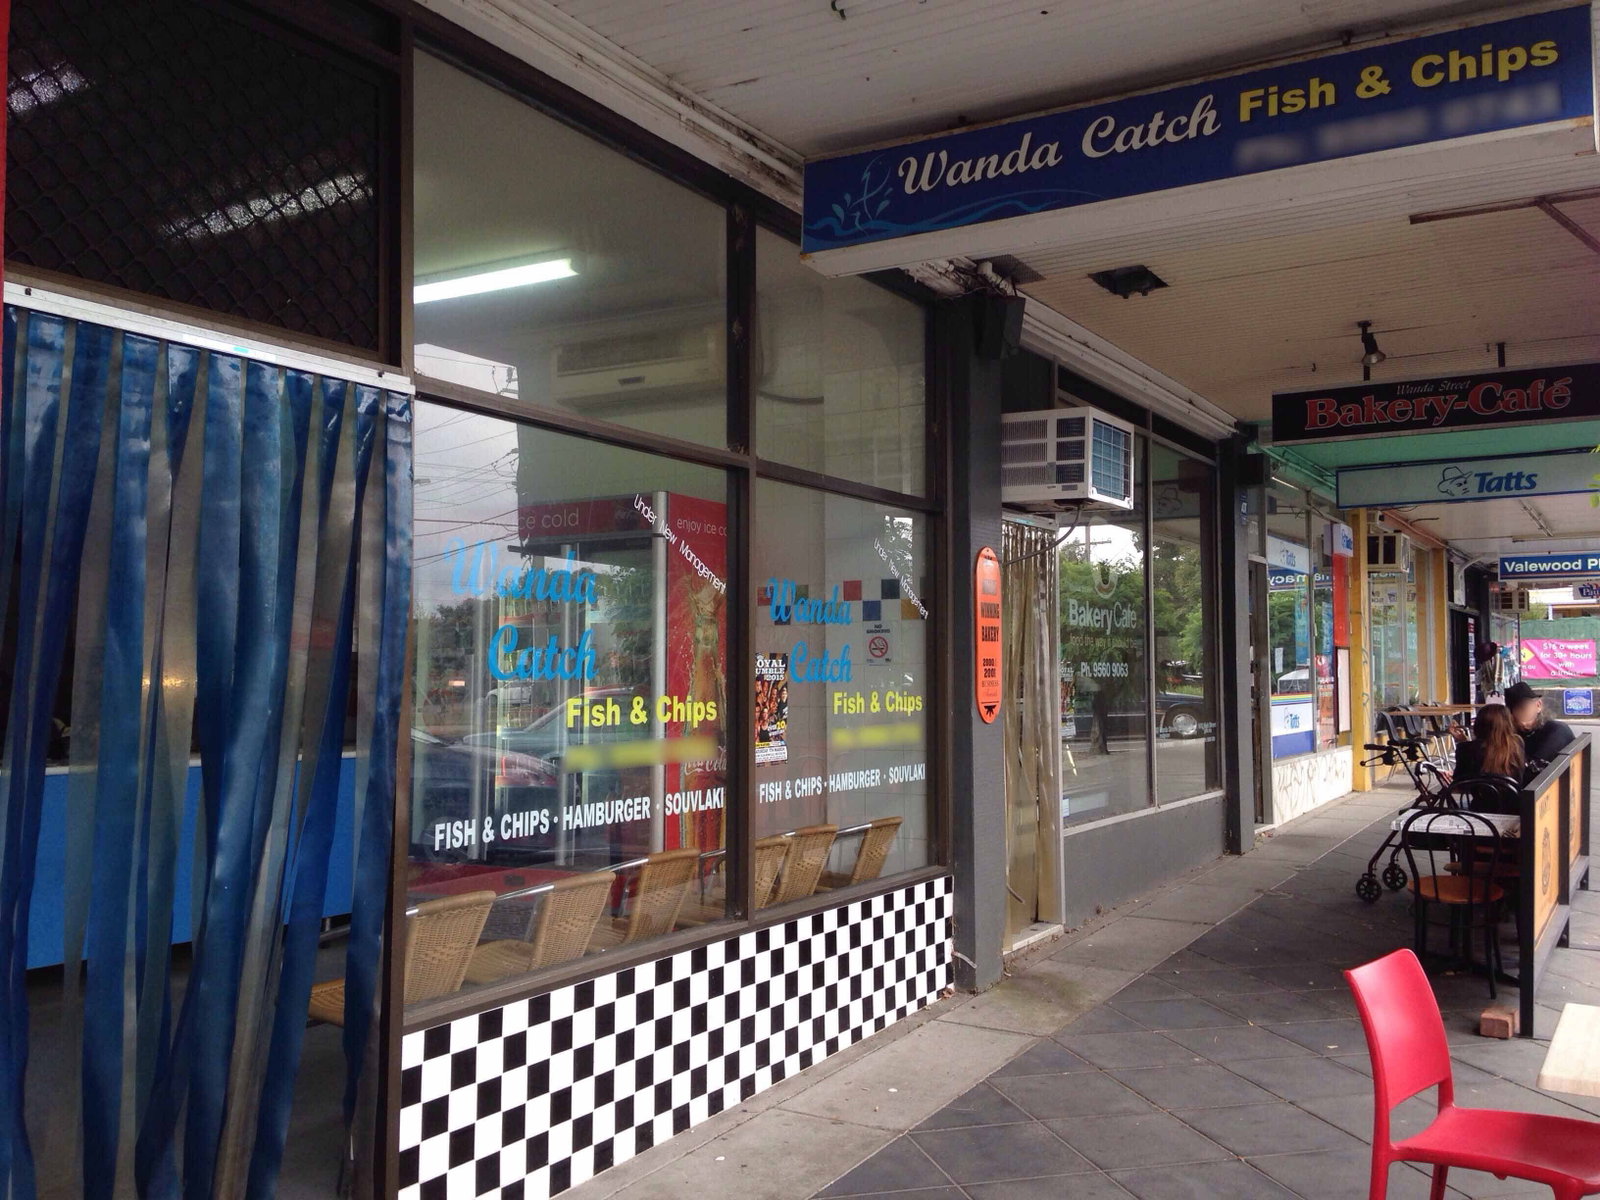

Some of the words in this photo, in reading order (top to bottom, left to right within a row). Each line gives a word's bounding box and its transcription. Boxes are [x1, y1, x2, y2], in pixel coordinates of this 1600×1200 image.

[898, 131, 1062, 195] Wanda
[1081, 94, 1221, 159] Catch
[1239, 75, 1335, 123] Fish
[1355, 65, 1391, 100] &
[1411, 39, 1559, 87] Chips
[1304, 376, 1573, 431] Bakery-Café
[1397, 381, 1435, 395] Wanda
[1438, 378, 1471, 392] Street
[1474, 471, 1538, 494] Tatts
[541, 508, 580, 528] cold
[677, 517, 702, 534] enjoy
[704, 521, 717, 533] ice
[633, 493, 658, 525] Under
[659, 519, 678, 544] New
[679, 539, 728, 595] Management
[444, 537, 600, 605] Wanda
[874, 537, 888, 561] Under
[900, 575, 929, 620] Management
[1504, 558, 1582, 573] Valewood
[765, 576, 853, 626] Wanda
[1069, 598, 1113, 636] Bakery
[488, 624, 600, 682] Catch
[981, 625, 1000, 643] BAKERY
[755, 667, 785, 675] UMBLE
[756, 659, 785, 668] OYAL
[789, 640, 853, 684] Catch
[567, 698, 620, 728] Fish
[630, 696, 648, 725] &
[656, 696, 717, 728] Chips
[833, 691, 865, 715] Fish
[870, 690, 881, 713] &
[885, 690, 923, 716] Chips
[759, 781, 782, 804] FISH
[785, 779, 792, 800] &
[795, 776, 823, 799] CHIPS
[829, 769, 881, 793] HAMBURGER
[888, 763, 926, 785] SOUVLAKI
[434, 818, 476, 851] FISH
[482, 816, 495, 843] &
[500, 808, 550, 841] CHIPS
[562, 796, 651, 831] HAMBURGER
[665, 787, 724, 816] SOUVLAKI
